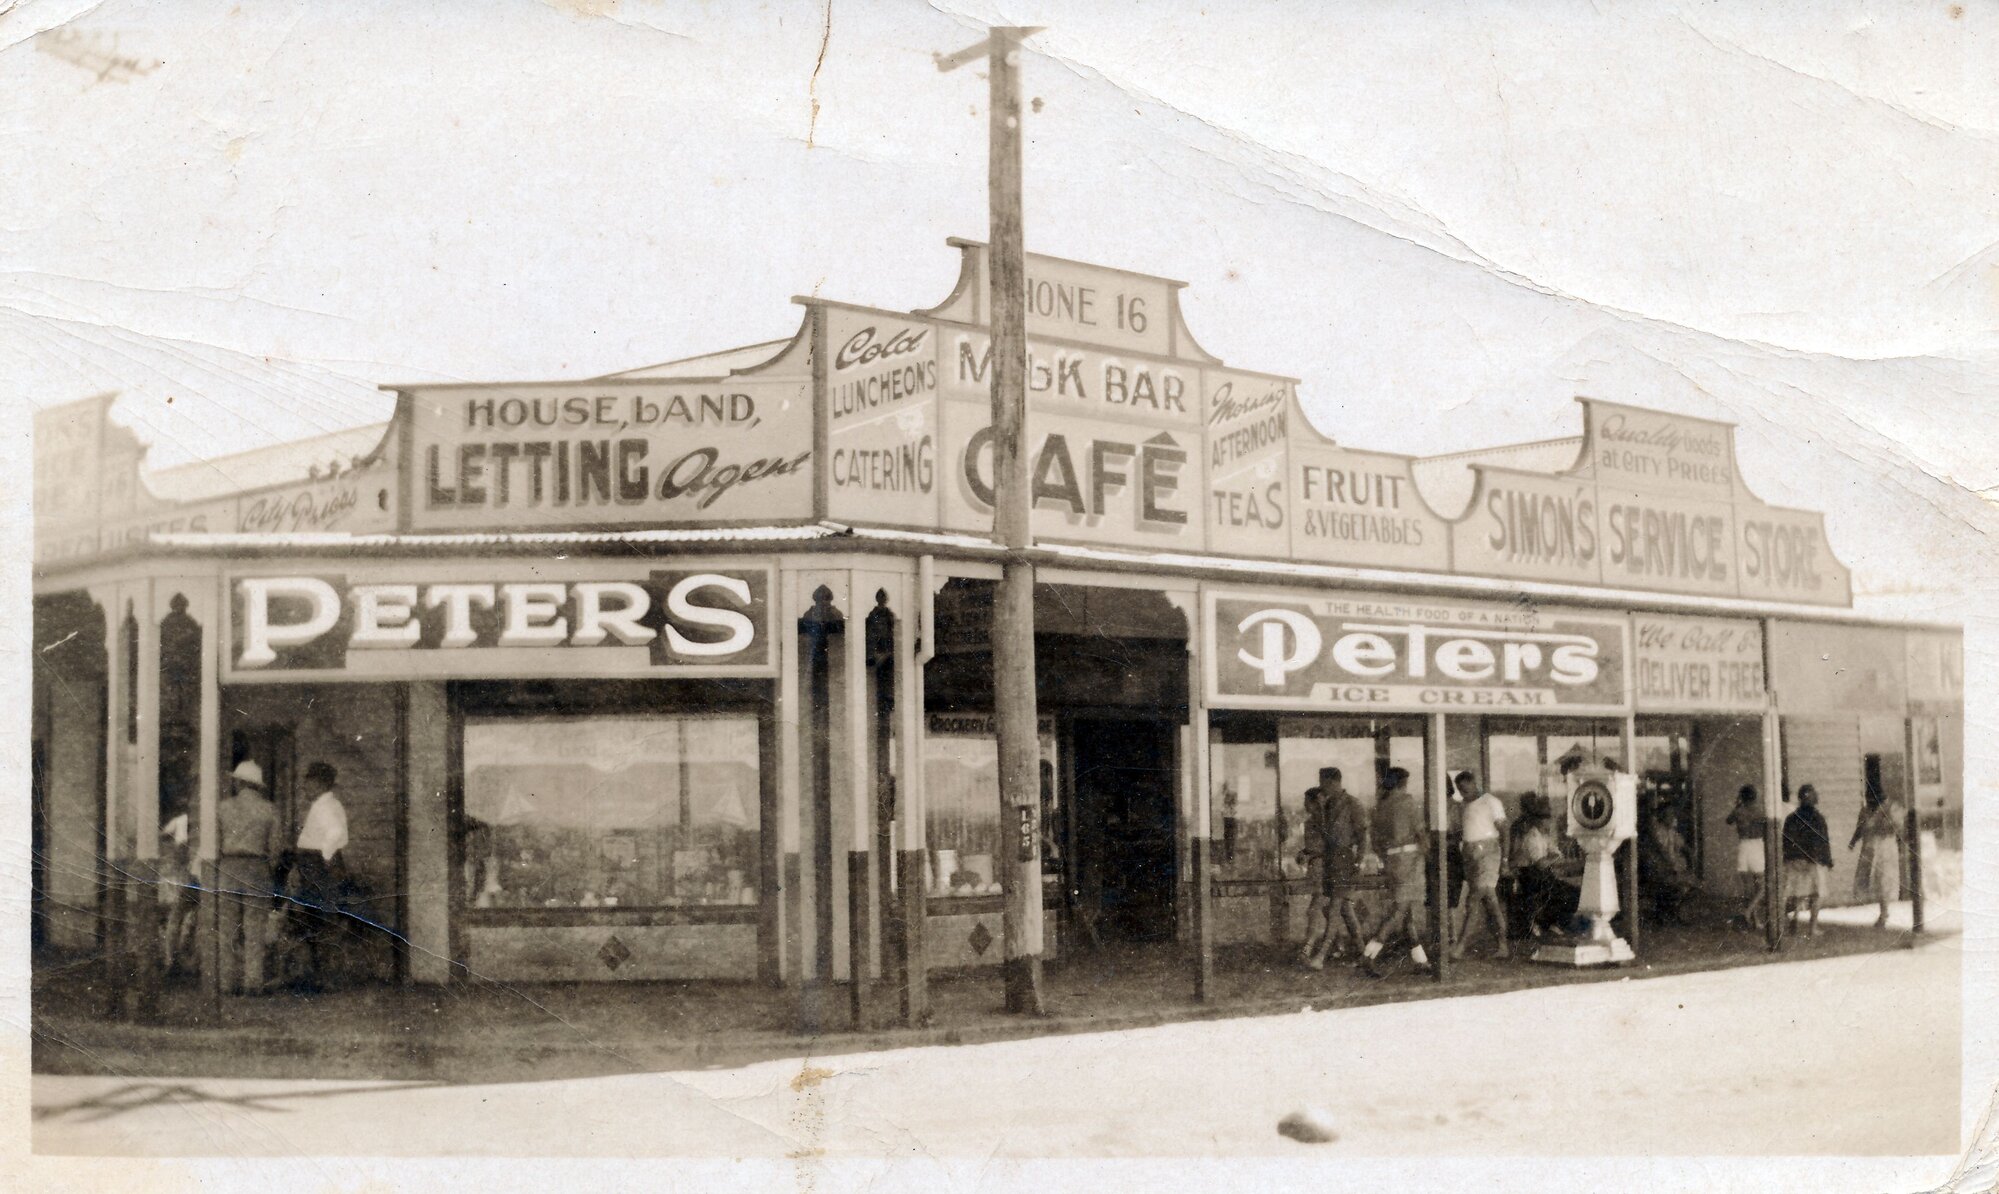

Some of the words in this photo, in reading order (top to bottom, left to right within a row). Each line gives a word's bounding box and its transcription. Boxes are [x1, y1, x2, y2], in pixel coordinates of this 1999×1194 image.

[1025, 277, 1097, 326] HONE
[1116, 293, 1148, 334] 16
[834, 326, 928, 372] Cold
[833, 359, 936, 420] LUNCHEONS
[959, 341, 1087, 398] MLK
[1105, 363, 1187, 414] BAR
[1208, 381, 1286, 425] Morning
[1211, 411, 1287, 470] AFTERNOON
[1601, 413, 1682, 456] Quality
[1602, 447, 1621, 471] at
[426, 437, 650, 508] LETTING
[658, 446, 813, 509] Agent
[833, 435, 934, 494] CATERING
[1302, 464, 1406, 509] FRUIT
[1213, 481, 1285, 530] TEAS
[1487, 486, 1596, 561] SIMON'S
[1609, 503, 1727, 582] SERVICE
[1743, 520, 1823, 591] STORE
[236, 574, 756, 667] PETERS
[1326, 601, 1350, 615] THE
[1356, 604, 1411, 618] HEALTH
[1416, 607, 1450, 621] FOOD
[1458, 610, 1474, 622] OF
[1479, 611, 1489, 623] A
[1494, 613, 1540, 626] NATION
[1639, 623, 1675, 649] We
[1681, 624, 1735, 653] Call
[1236, 607, 1600, 686] Peters
[1330, 686, 1391, 704] ICE
[1418, 687, 1547, 706] CREAM
[1639, 657, 1711, 699] DELIVER
[1717, 660, 1763, 699] FREE
